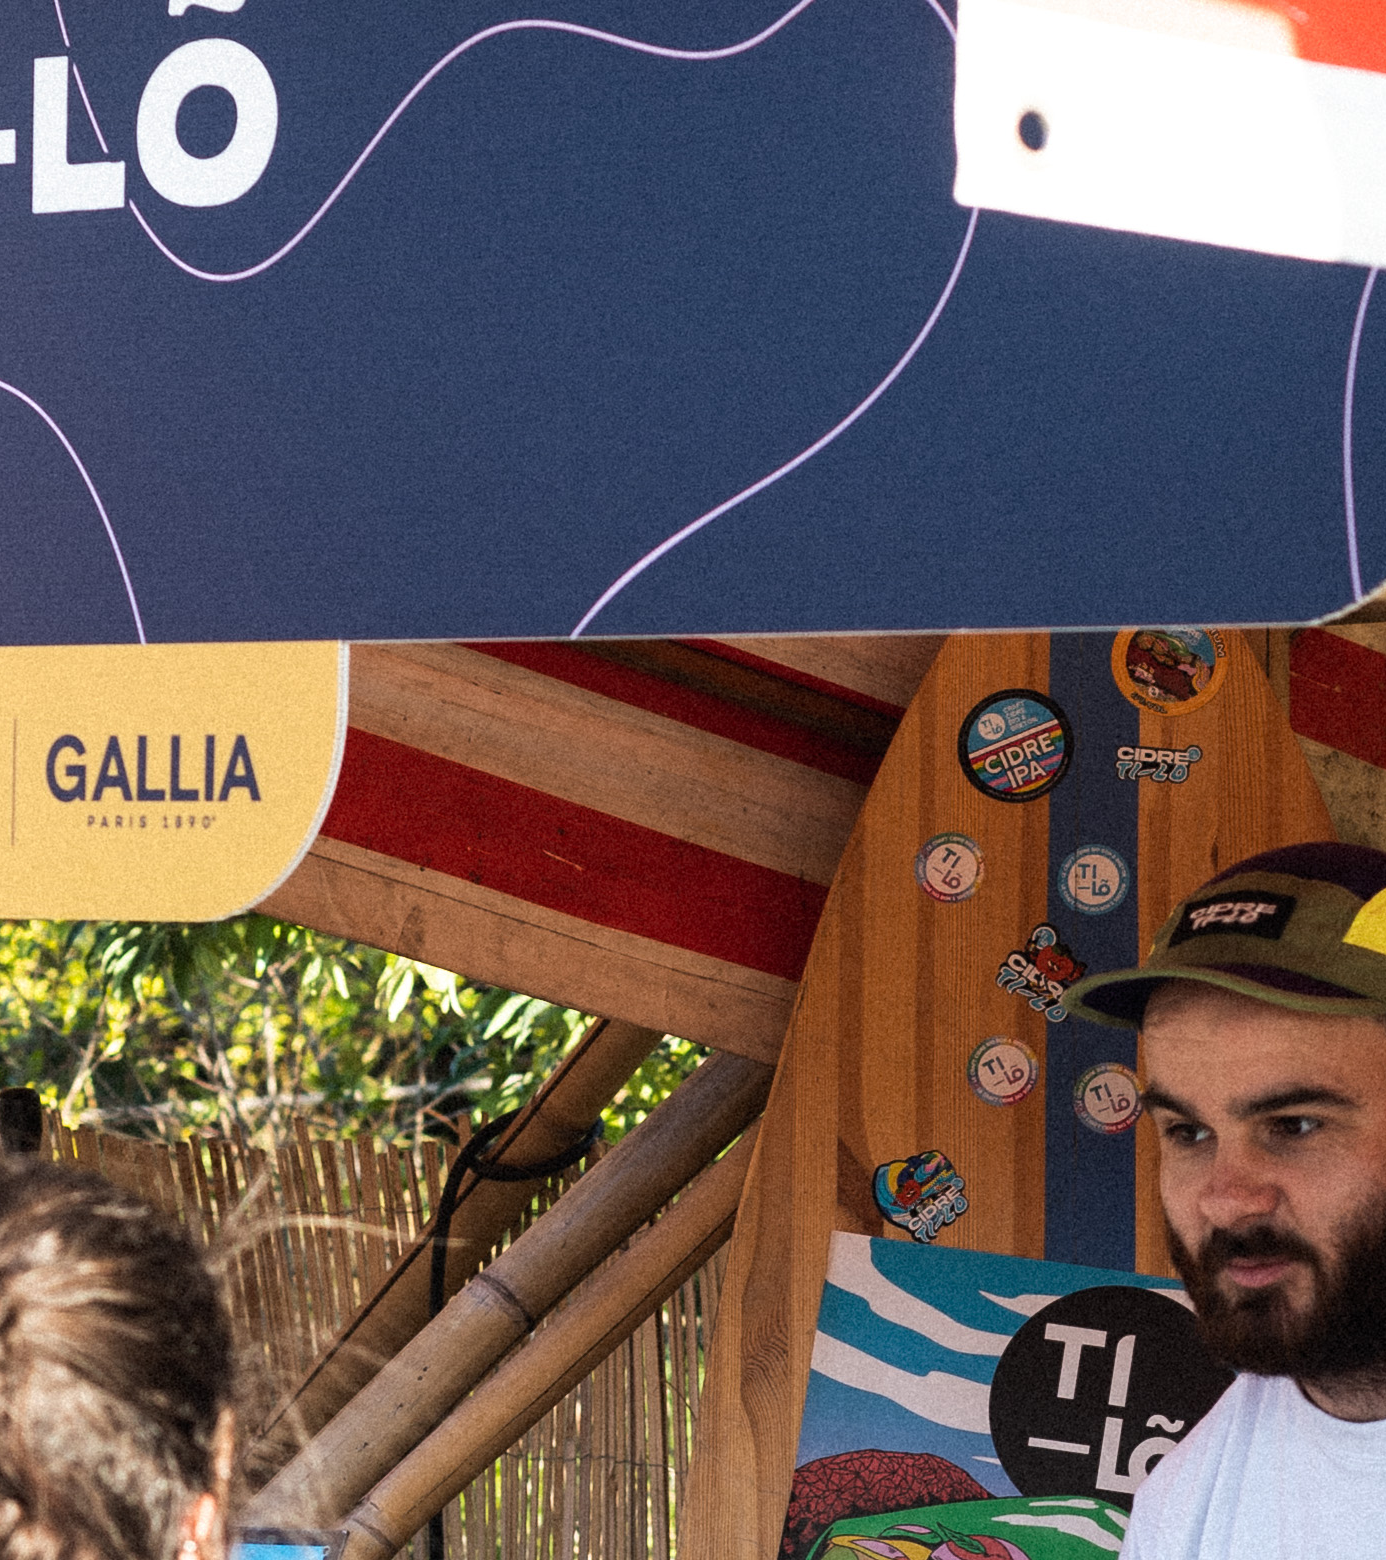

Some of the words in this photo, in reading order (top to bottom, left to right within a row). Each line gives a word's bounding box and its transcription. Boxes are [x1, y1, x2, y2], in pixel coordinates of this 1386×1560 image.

[984, 732, 1055, 774] CIDRE
[1117, 746, 1190, 765] CIDRE
[46, 735, 261, 801] GALLIA
[1007, 761, 1047, 789] IPA
[87, 815, 148, 828] PARIS
[941, 847, 961, 868] TI
[1078, 863, 1097, 879] TI
[982, 1056, 1005, 1075] TI
[1089, 1083, 1111, 1102] TI
[908, 1185, 963, 1231] CIDRE
[1045, 1323, 1136, 1407] TI
